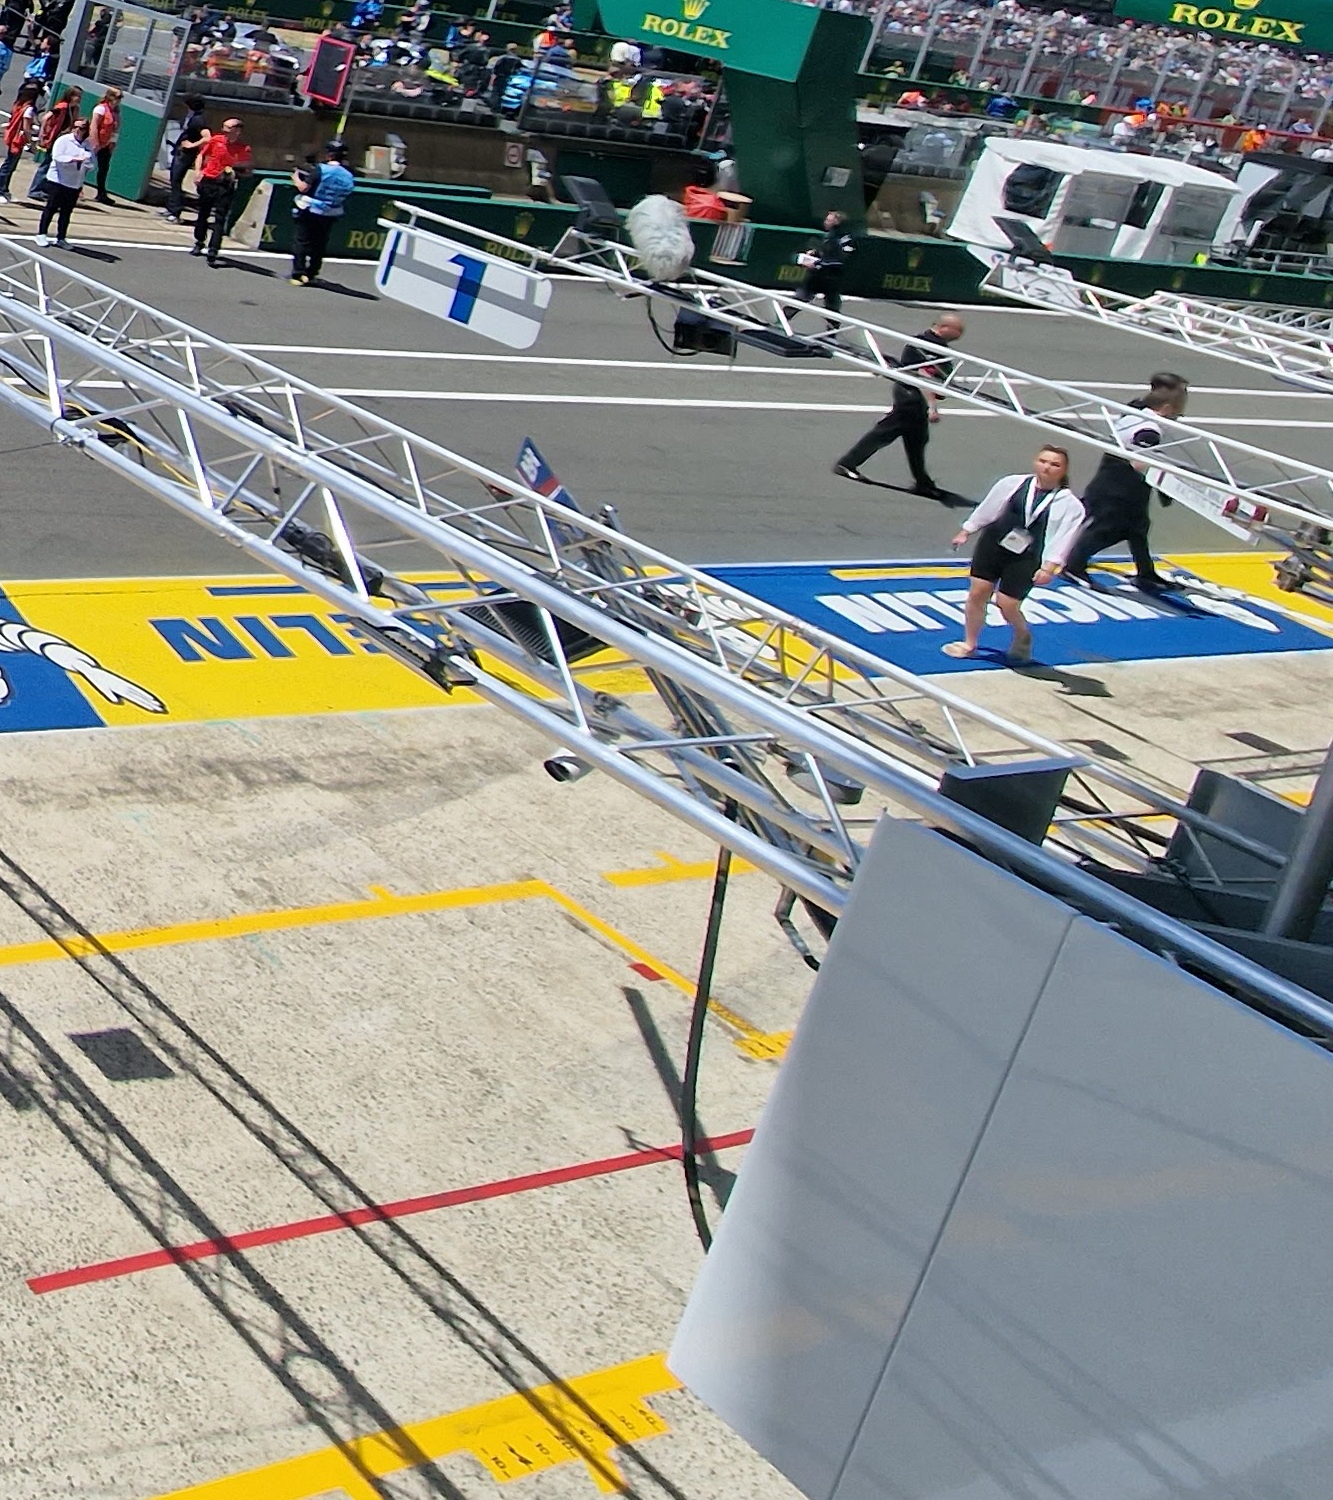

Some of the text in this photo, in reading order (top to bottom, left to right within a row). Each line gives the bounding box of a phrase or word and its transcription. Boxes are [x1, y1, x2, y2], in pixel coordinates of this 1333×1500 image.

[641, 13, 733, 50] ROLEX
[1168, 2, 1307, 44] ROLEX
[447, 252, 488, 326] 1
[882, 274, 932, 292] ROLEX
